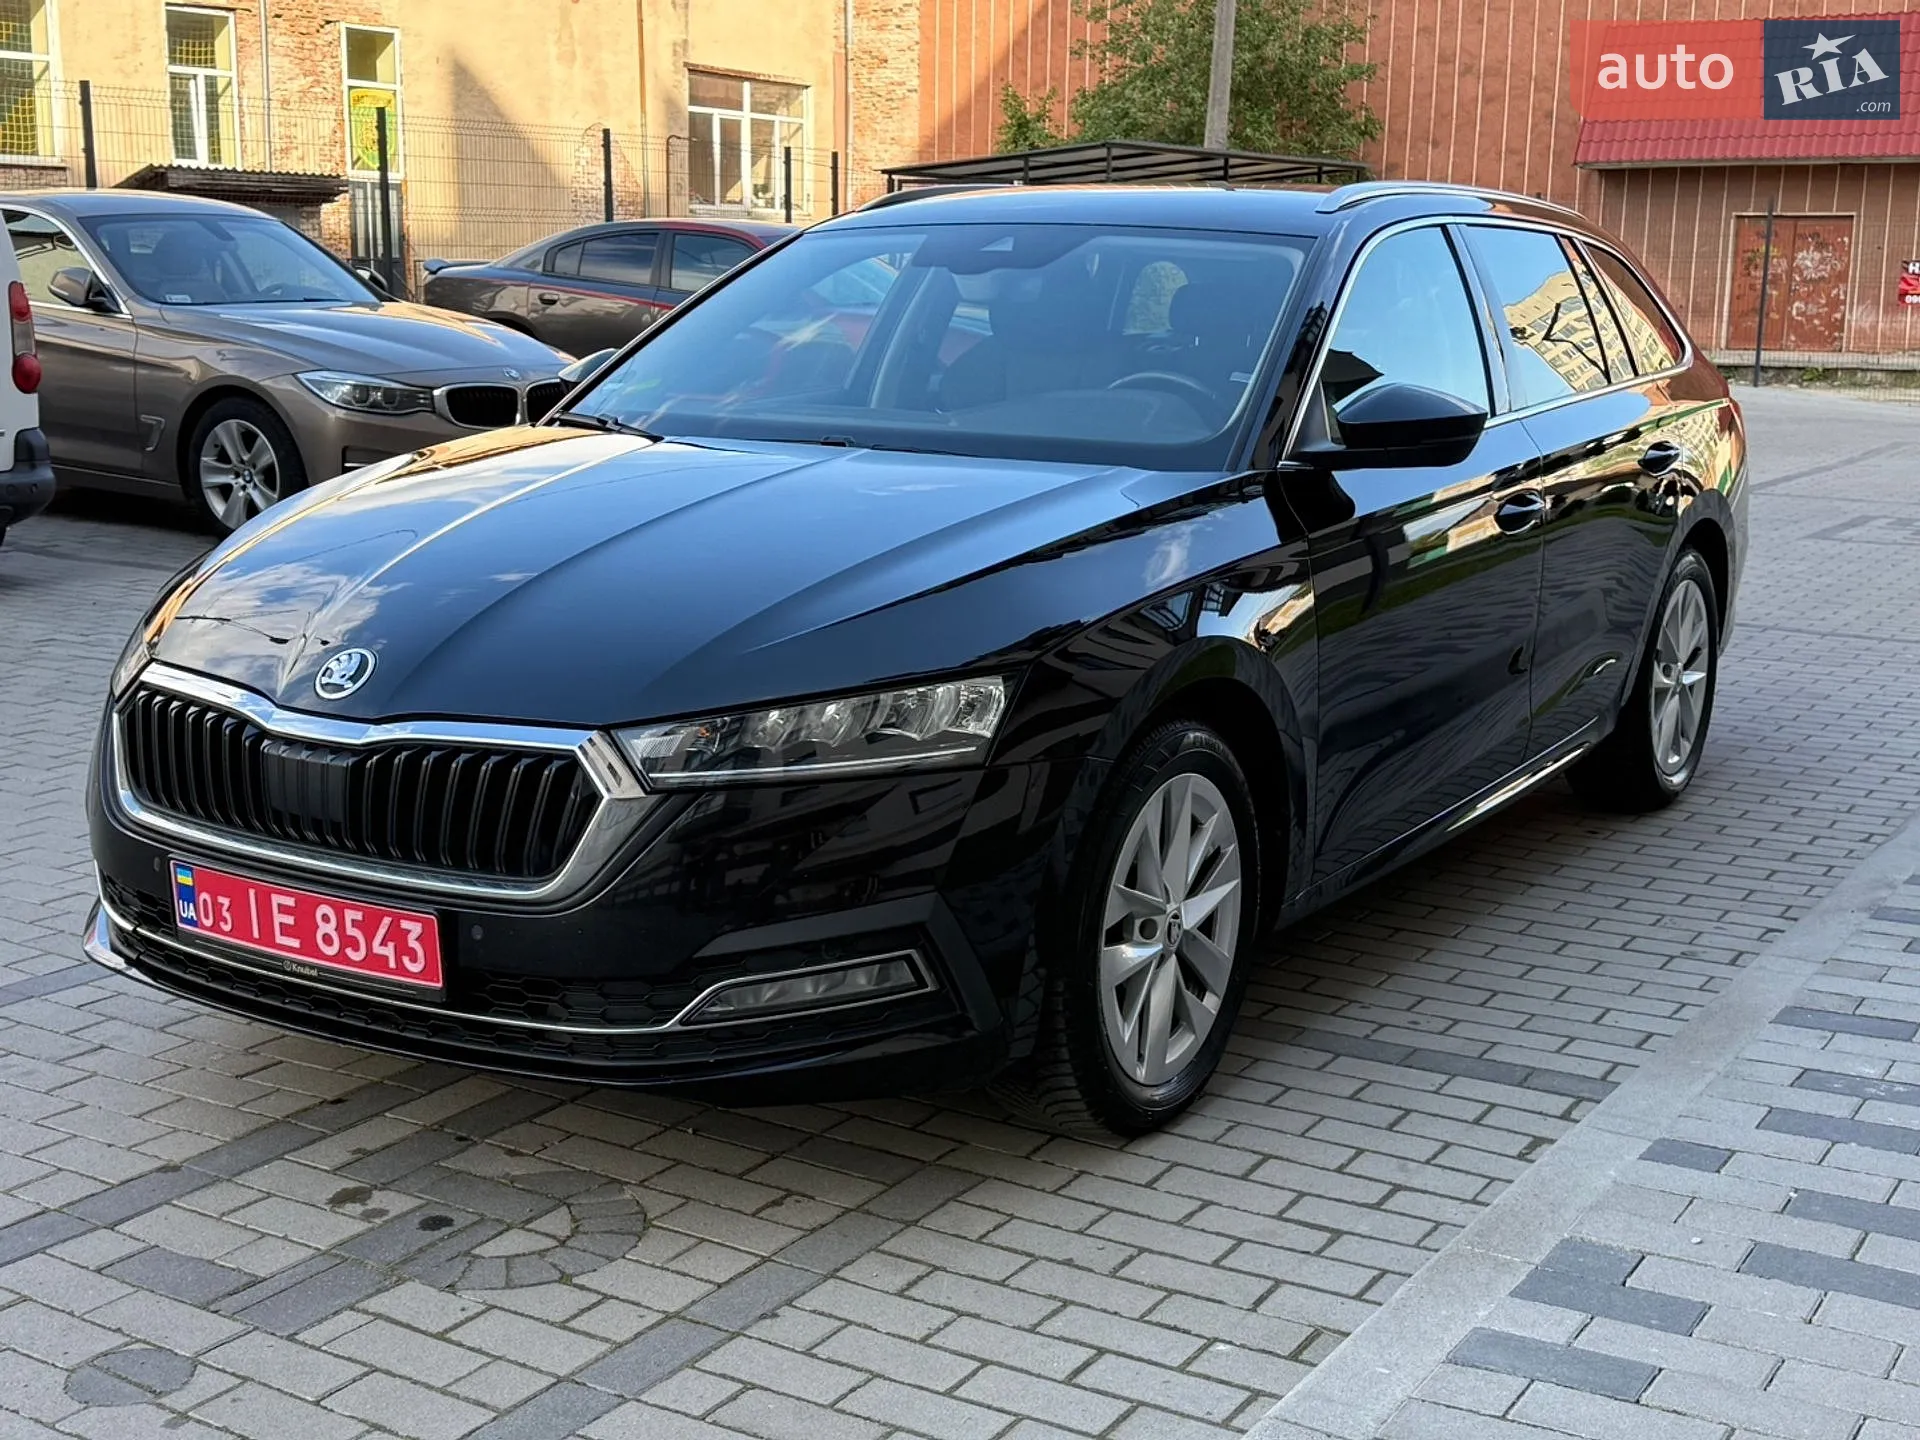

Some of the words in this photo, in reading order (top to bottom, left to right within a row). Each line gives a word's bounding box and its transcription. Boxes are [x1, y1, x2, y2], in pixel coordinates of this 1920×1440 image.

[179, 899, 197, 921] UA
[199, 891, 232, 932] 03
[248, 888, 300, 948] IE
[315, 904, 426, 973] 8543
